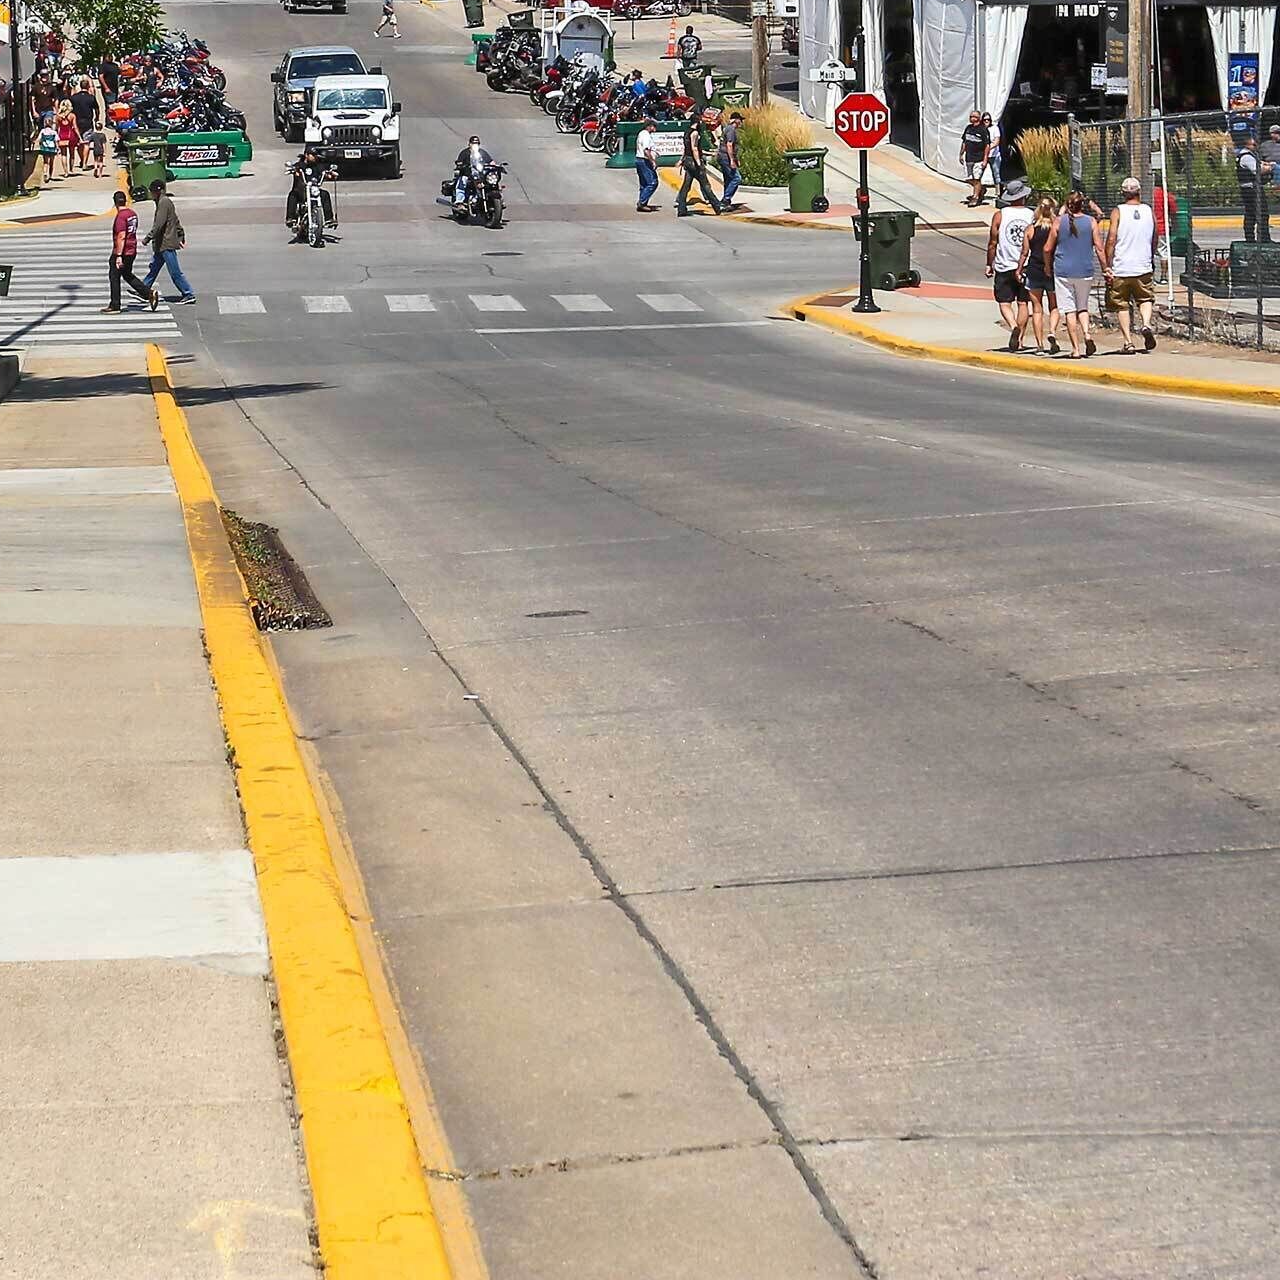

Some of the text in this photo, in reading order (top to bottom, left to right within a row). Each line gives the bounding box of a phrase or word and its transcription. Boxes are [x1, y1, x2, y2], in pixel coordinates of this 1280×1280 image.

[819, 70, 835, 79] Main
[837, 110, 887, 132] STOP
[179, 150, 219, 161] AMSOIL
